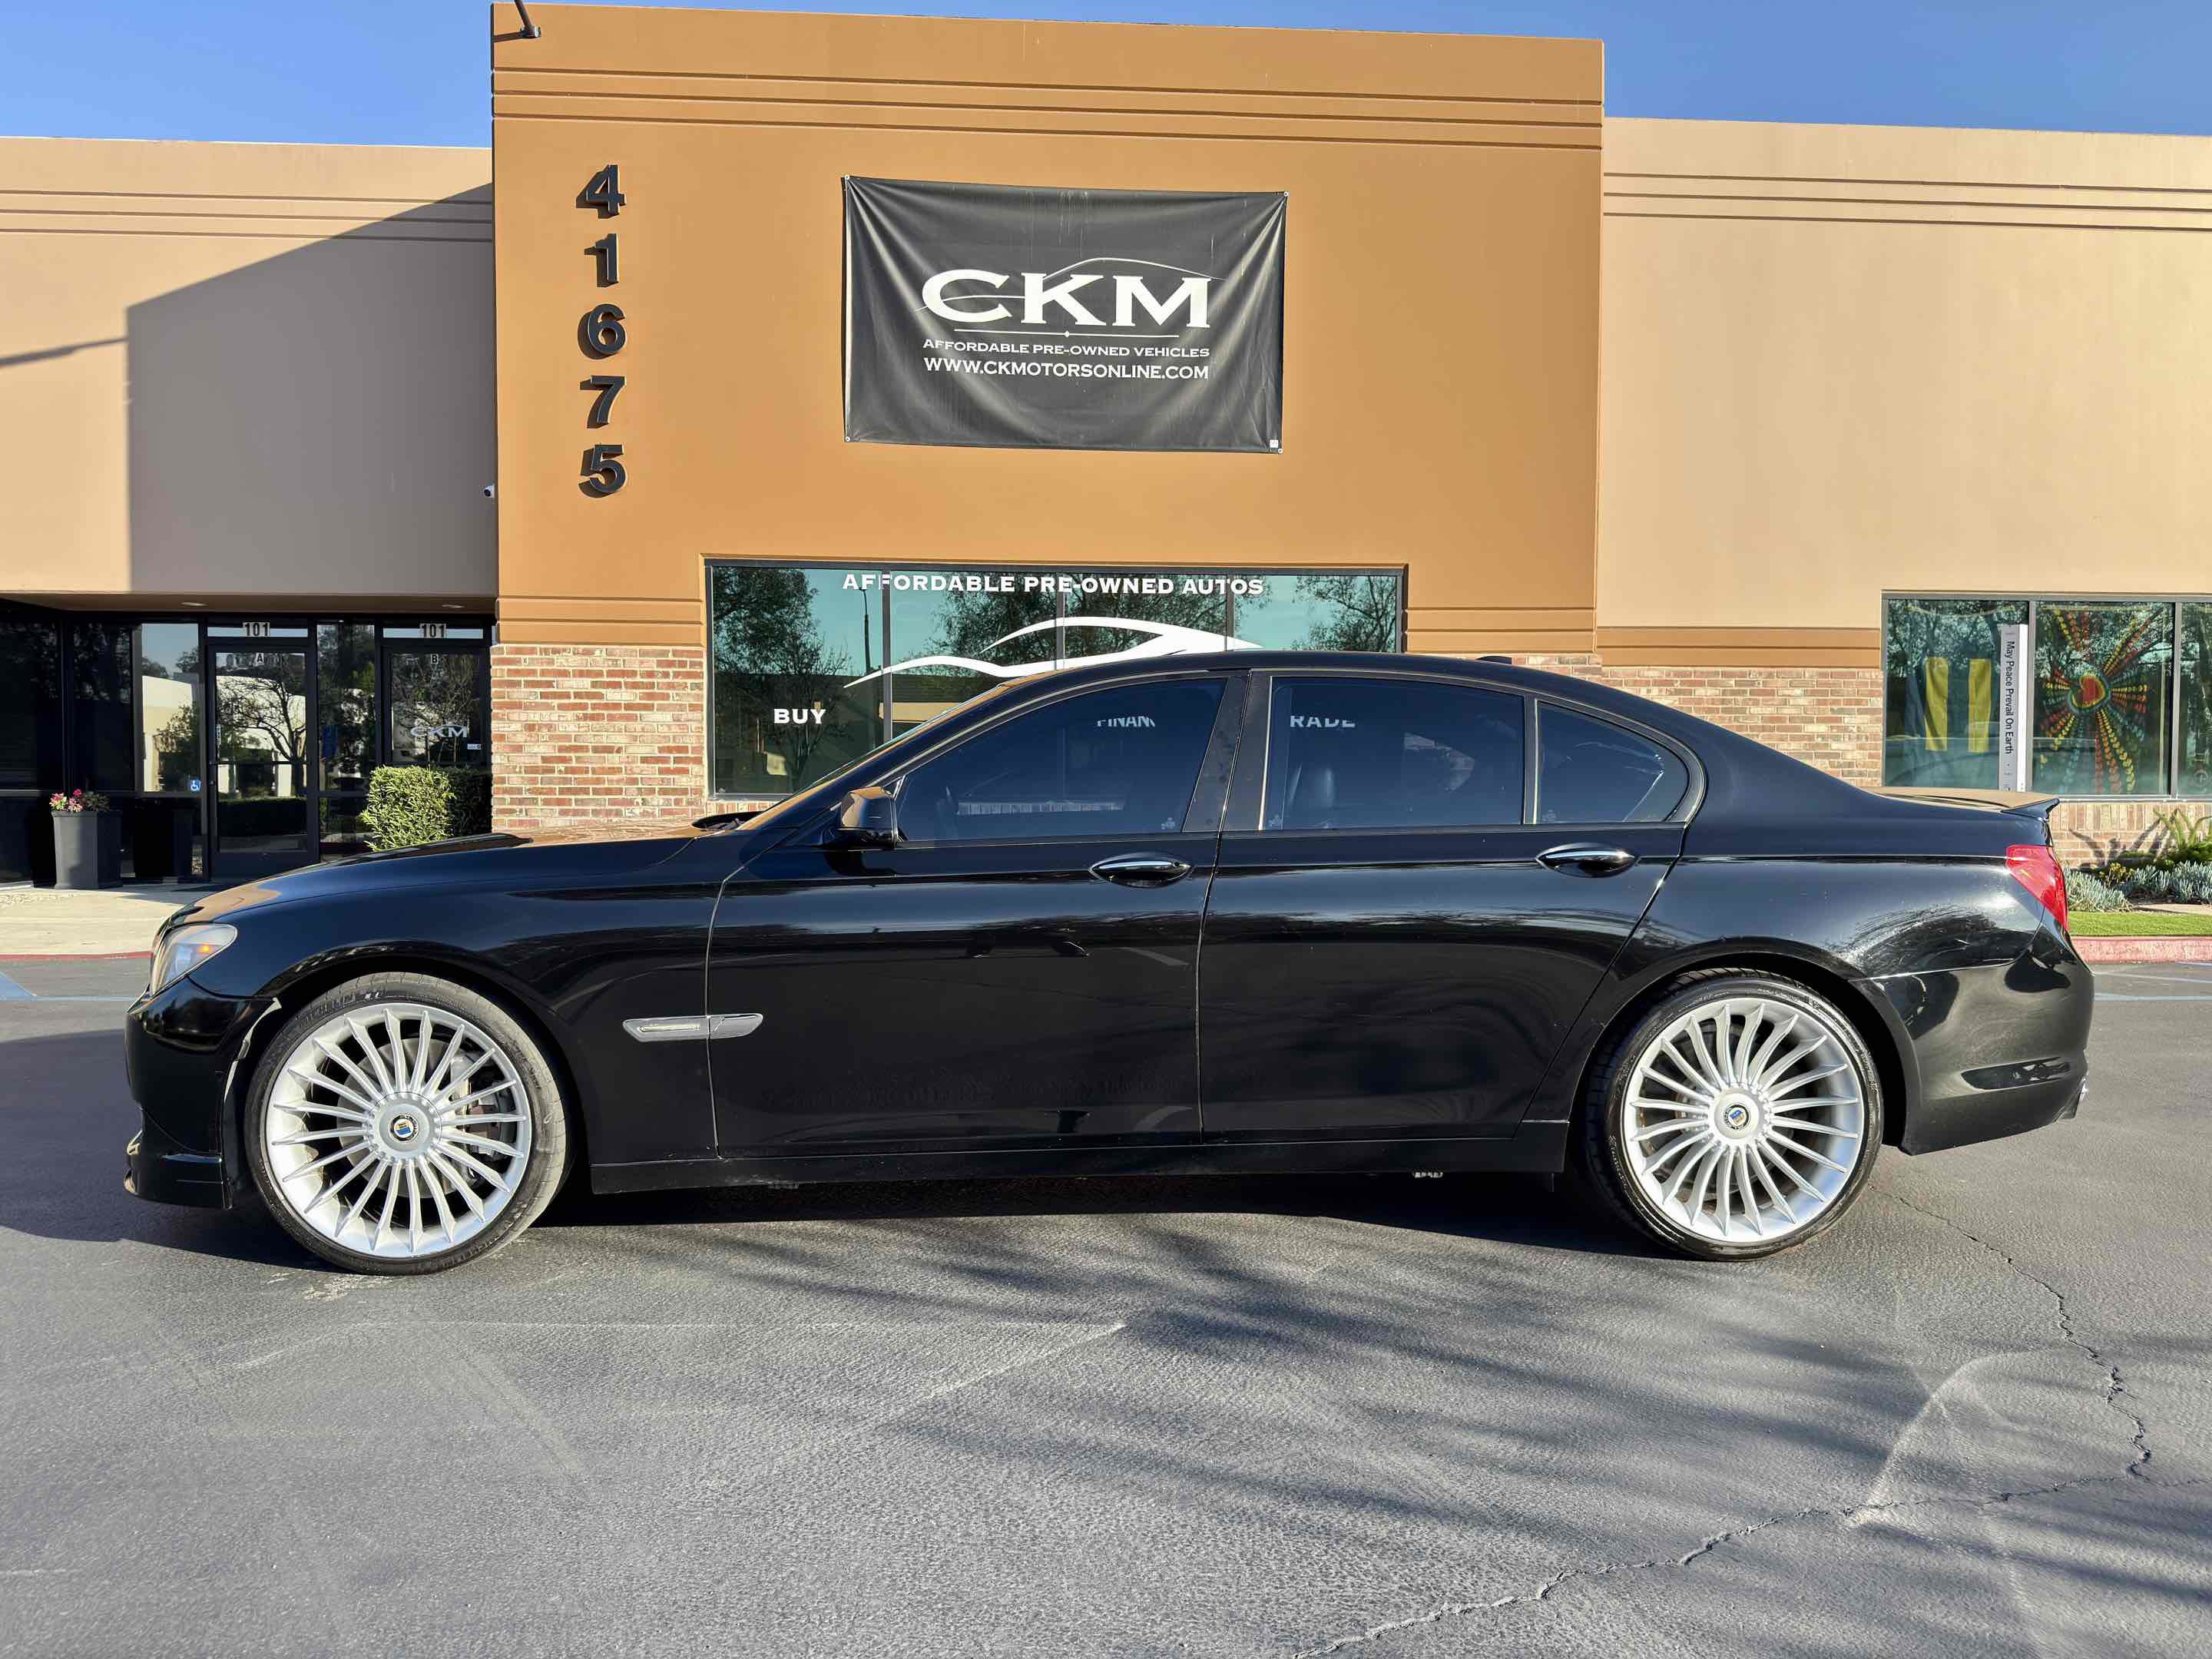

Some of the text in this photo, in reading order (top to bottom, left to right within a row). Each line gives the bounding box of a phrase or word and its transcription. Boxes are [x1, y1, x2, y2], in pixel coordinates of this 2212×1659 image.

[922, 269, 1211, 328] CKM
[579, 164, 627, 496] 41675
[923, 339, 1210, 358] AFFORDABLE PRE-OWNED VEHICLES
[923, 356, 1210, 379] WWW.CKMOTORSONLINE.COM
[843, 573, 1264, 595] AFFORDABLE PRE-OWNED AUTOS
[244, 622, 270, 637] 101
[422, 623, 445, 638] 101
[257, 653, 264, 664] A
[431, 654, 439, 664] B
[2004, 641, 2015, 754] May Peace Prevail On Earth
[773, 708, 826, 724] BUY
[410, 725, 468, 738] CKM
